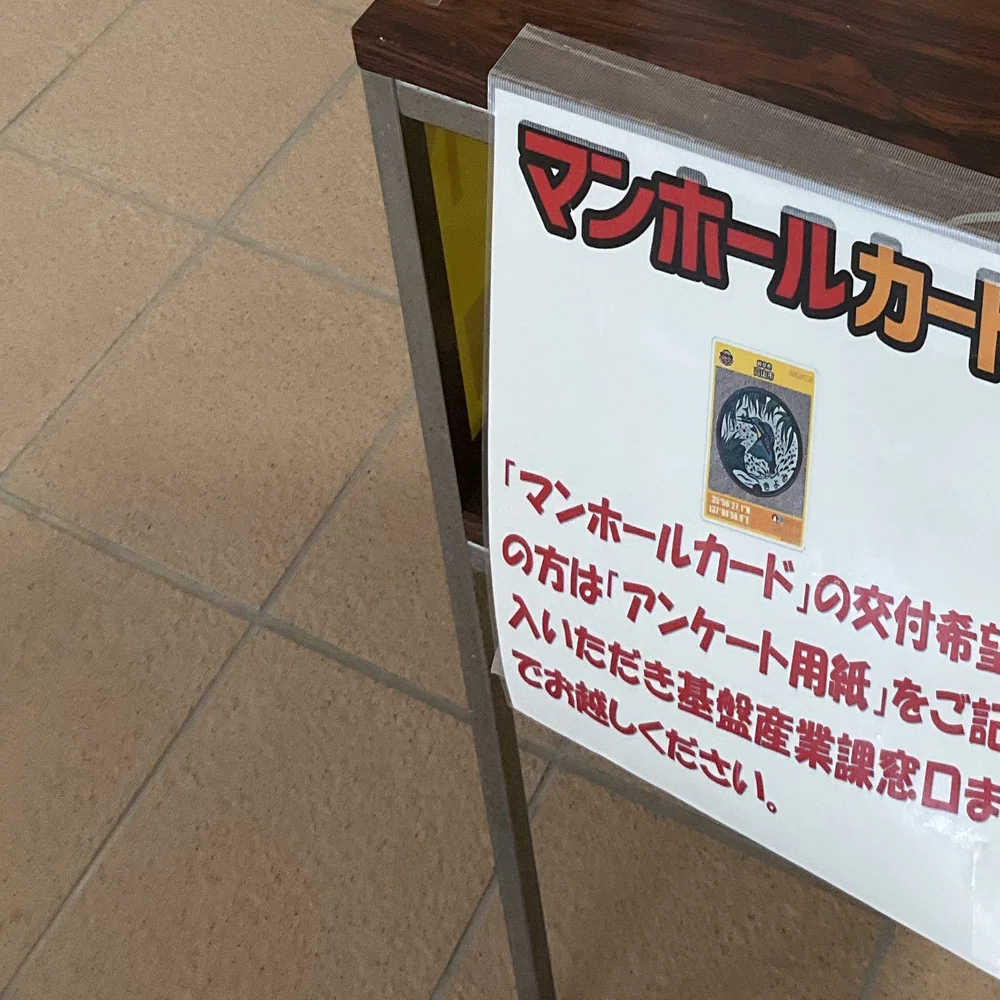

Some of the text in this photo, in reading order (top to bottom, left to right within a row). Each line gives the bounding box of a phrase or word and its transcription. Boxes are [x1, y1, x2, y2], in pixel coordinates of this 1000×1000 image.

[511, 650, 778, 814] でお越しください。
